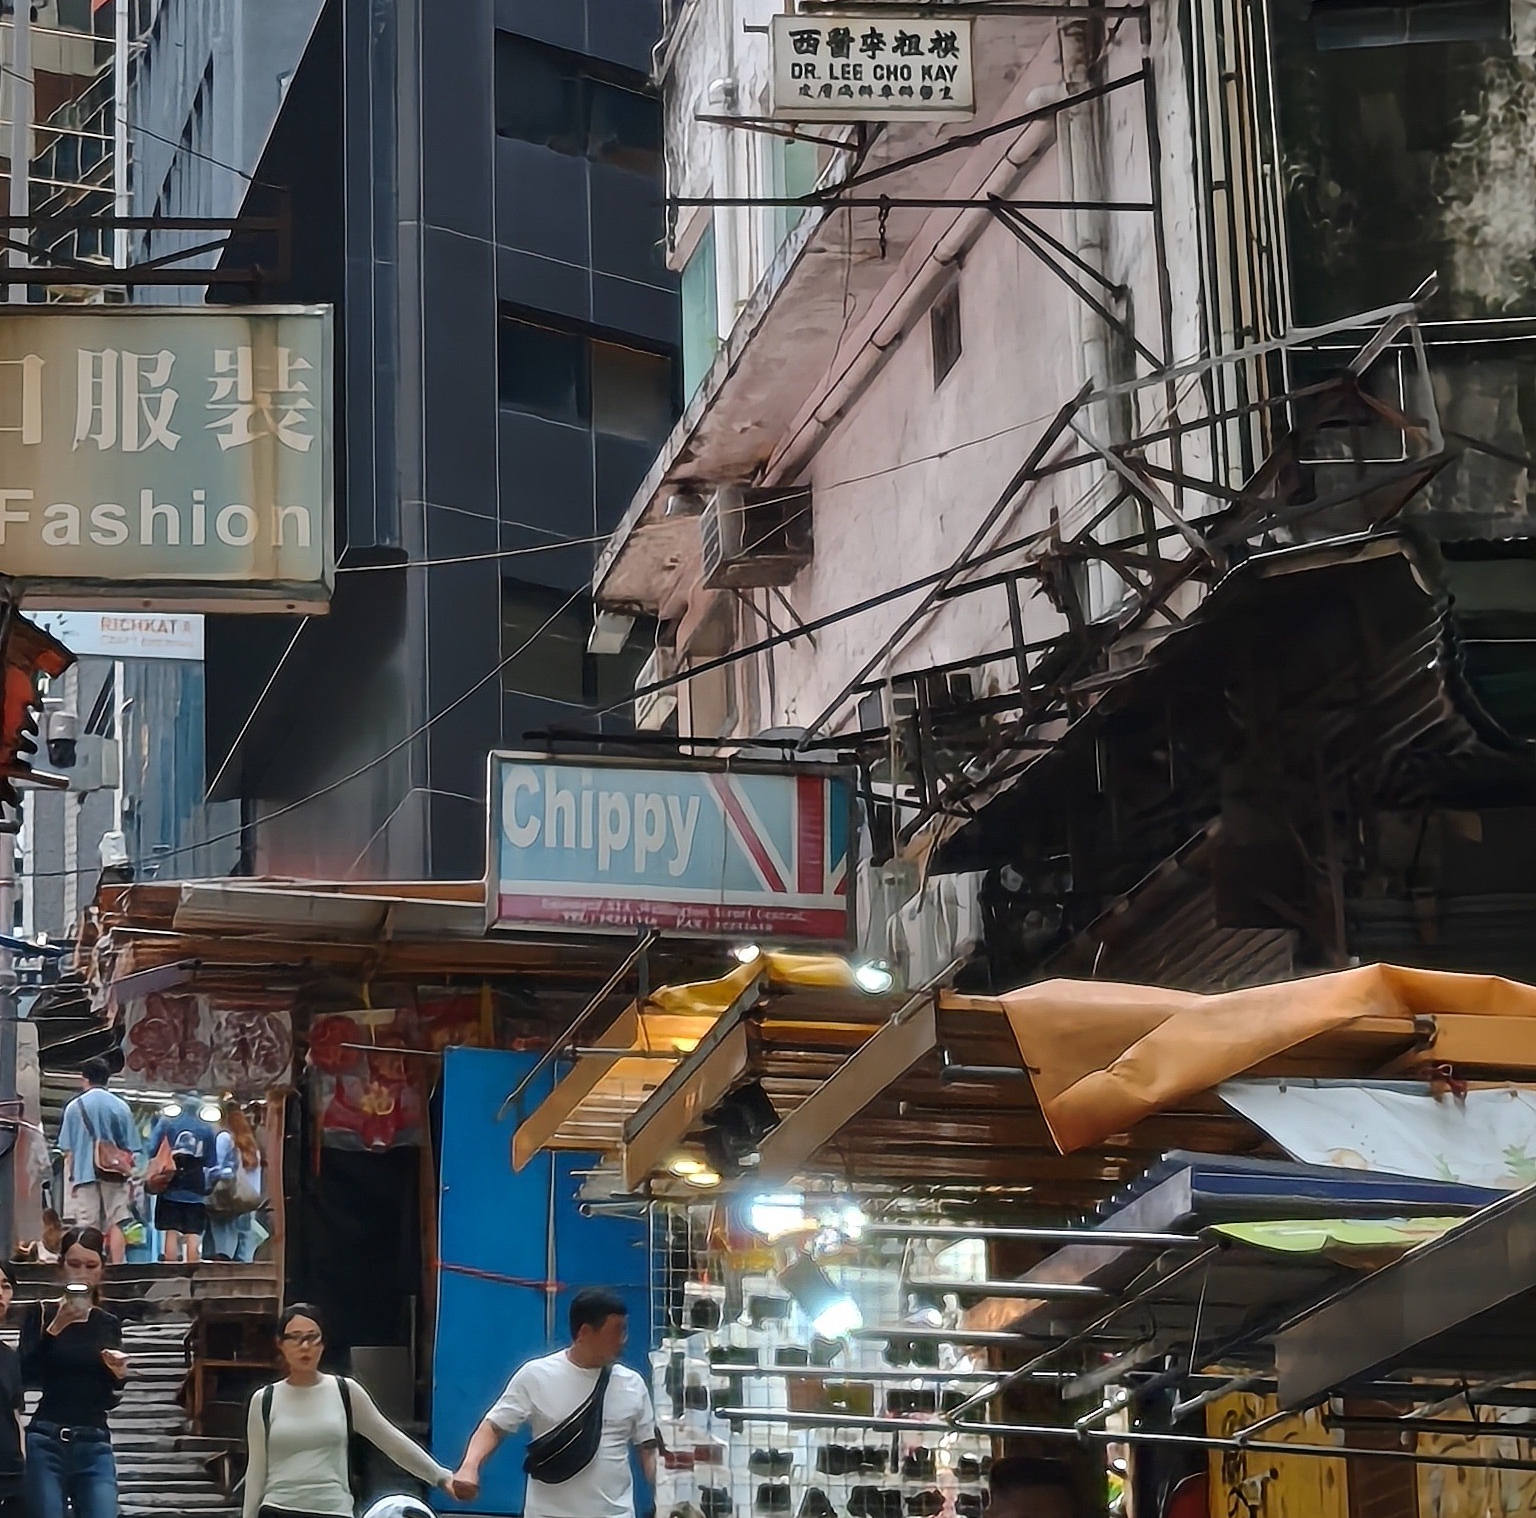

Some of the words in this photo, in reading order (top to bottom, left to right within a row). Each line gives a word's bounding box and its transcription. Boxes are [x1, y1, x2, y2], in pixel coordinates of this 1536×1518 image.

[791, 63, 821, 80] DR.
[829, 63, 863, 81] LEE
[873, 64, 912, 82] CHO
[921, 65, 958, 83] KAY
[502, 766, 701, 877] Chippy
